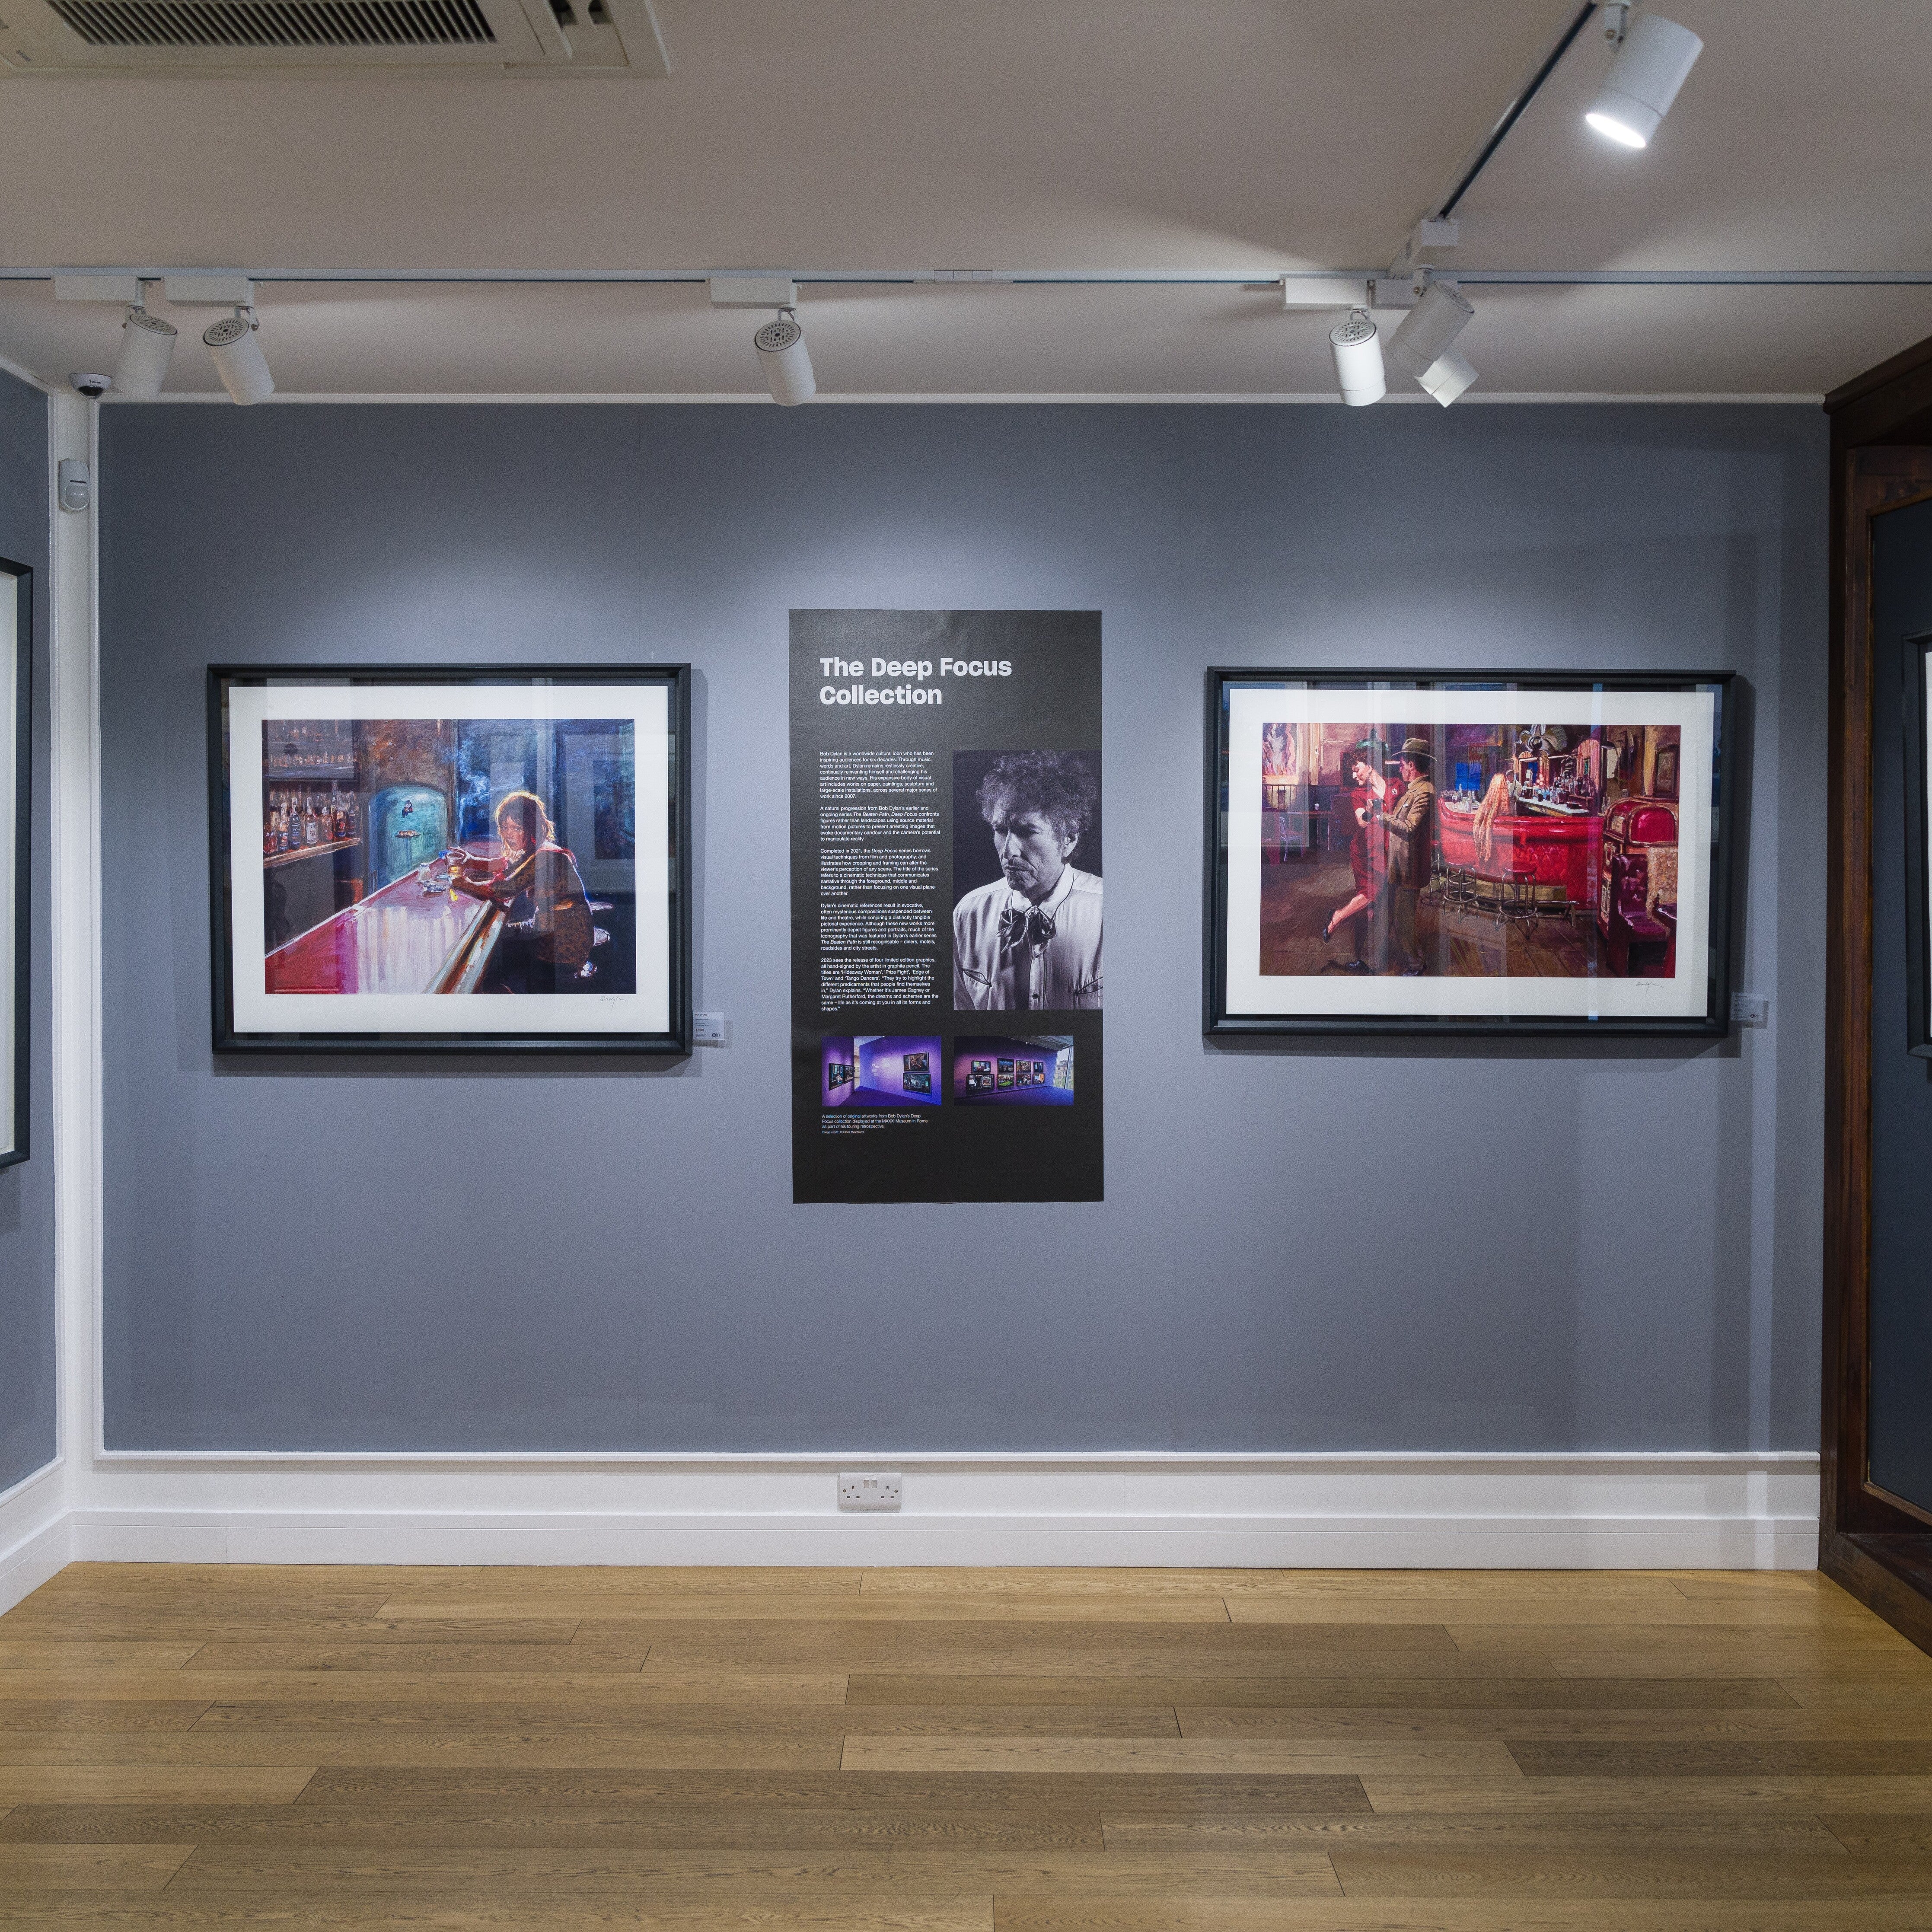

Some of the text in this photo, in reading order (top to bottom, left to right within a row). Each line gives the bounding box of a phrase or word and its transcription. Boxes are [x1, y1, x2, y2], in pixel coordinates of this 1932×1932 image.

[820, 657, 1011, 680] The Deep Focus
[820, 684, 942, 705] Collection
